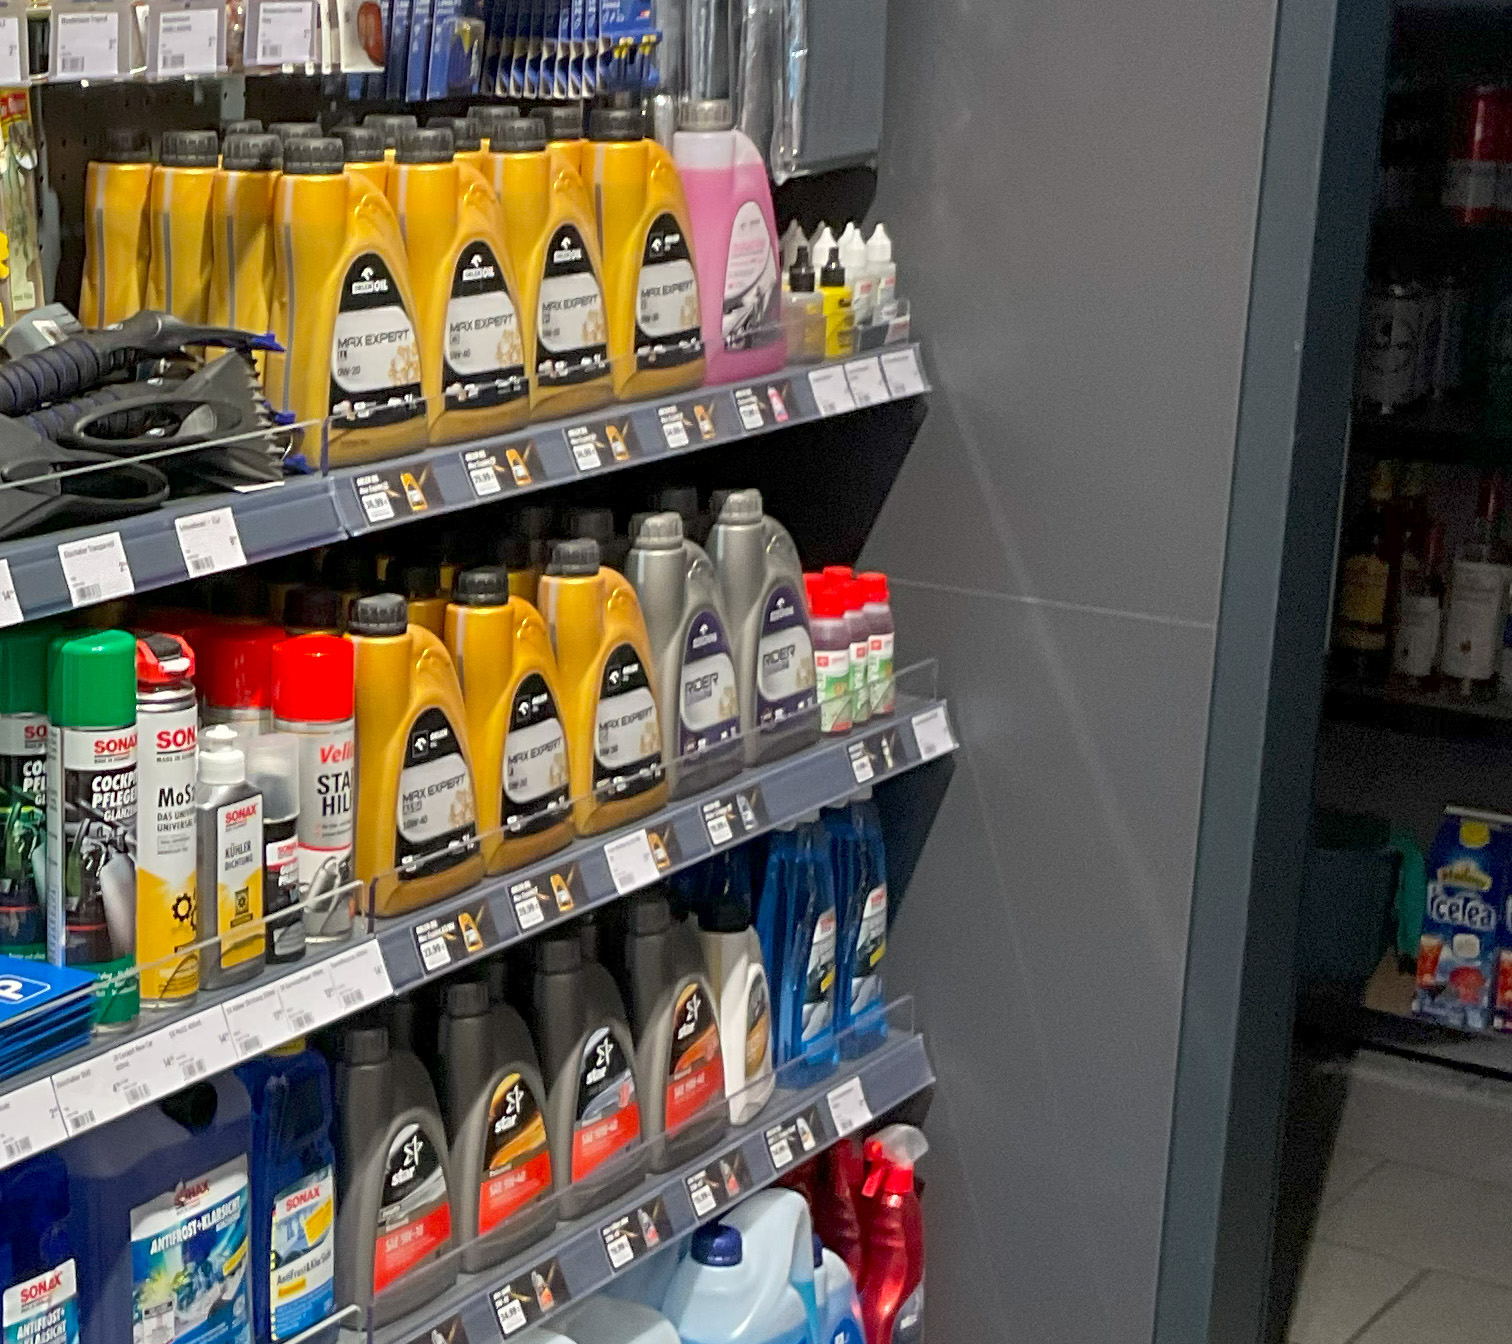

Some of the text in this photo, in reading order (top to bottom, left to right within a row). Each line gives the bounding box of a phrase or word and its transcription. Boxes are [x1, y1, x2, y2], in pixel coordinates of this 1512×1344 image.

[449, 313, 514, 335] MAX EXPERT
[337, 328, 410, 351] MAX EXPERT
[91, 771, 137, 792] COCKP
[316, 773, 352, 796] STA
[156, 812, 173, 823] DAS
[224, 802, 258, 825] SONAX
[224, 841, 252, 860] KÜHLER
[493, 1113, 518, 1135] star
[390, 1164, 416, 1188] star
[20, 1274, 62, 1304] SONAX
